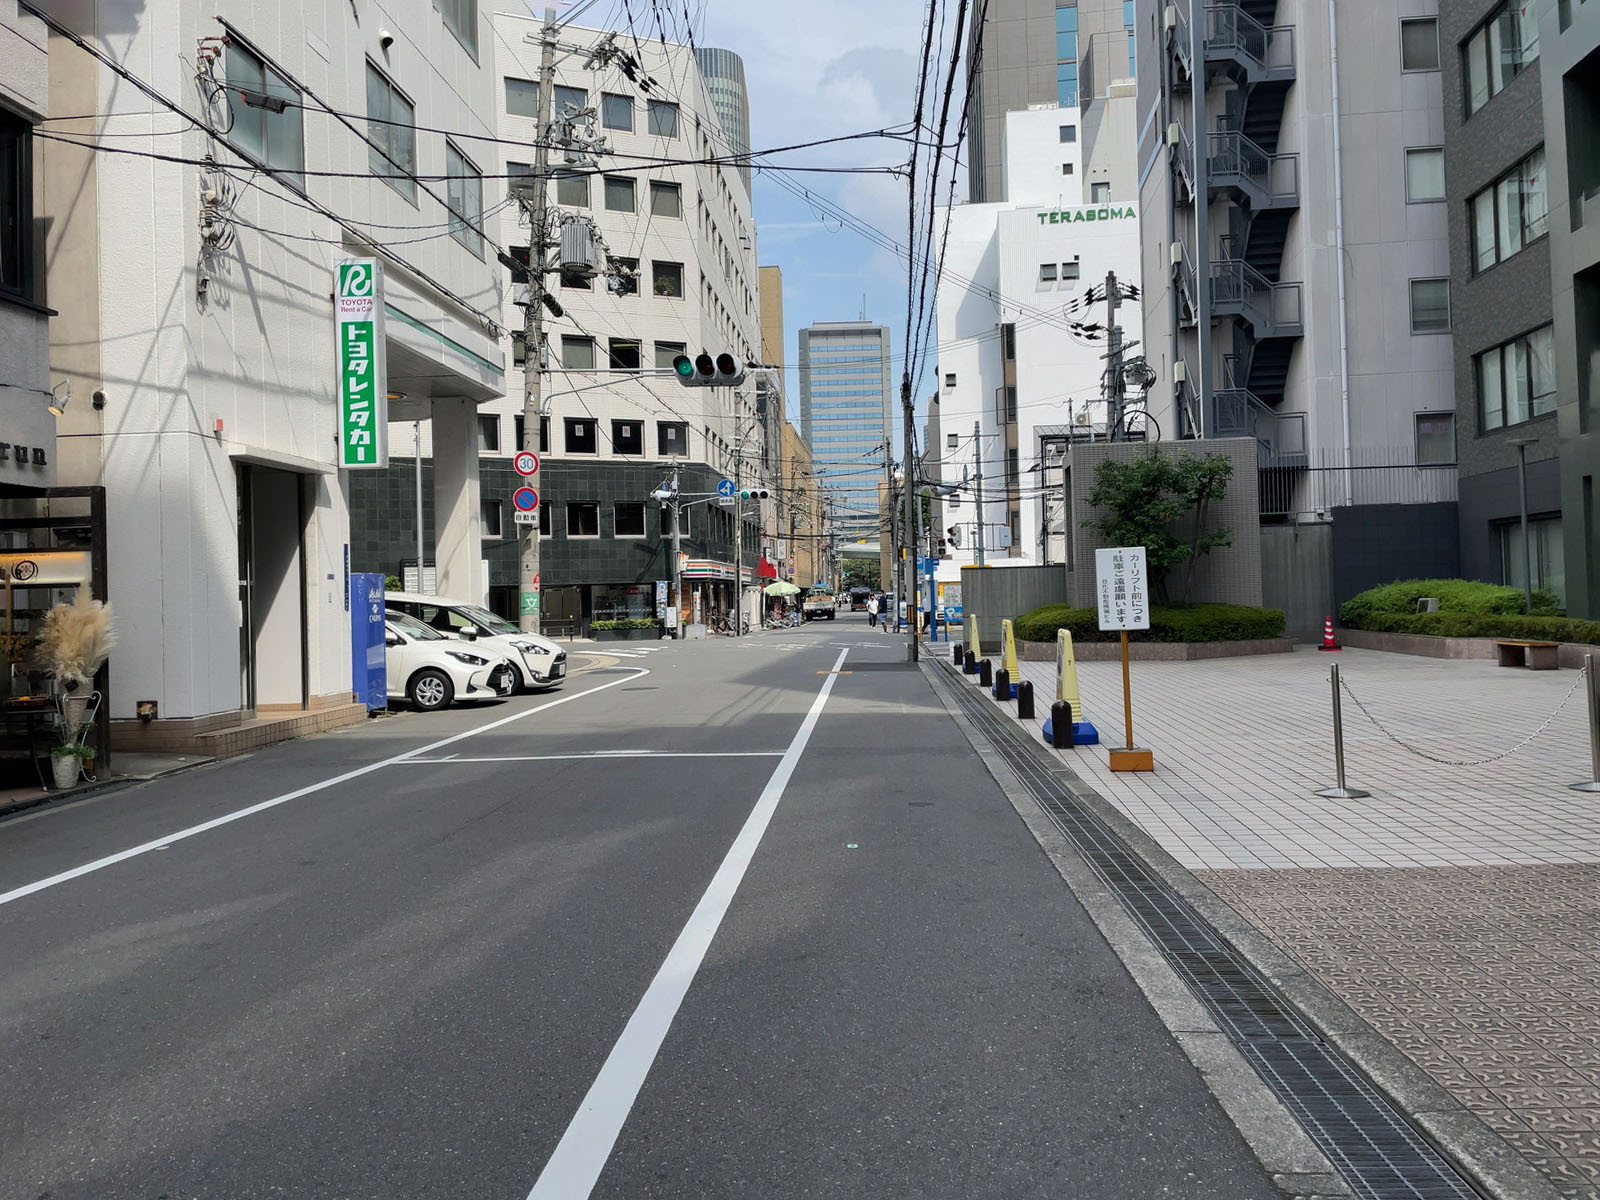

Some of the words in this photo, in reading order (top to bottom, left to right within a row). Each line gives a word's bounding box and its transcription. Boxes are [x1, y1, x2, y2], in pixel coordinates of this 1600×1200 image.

[1037, 207, 1136, 225] TERASOMA
[347, 324, 370, 462] トヨタレンタカー
[520, 458, 534, 469] 30
[1112, 554, 1127, 623] 駐車ご遠慮願います
[1129, 553, 1144, 623] カーリフト前につき
